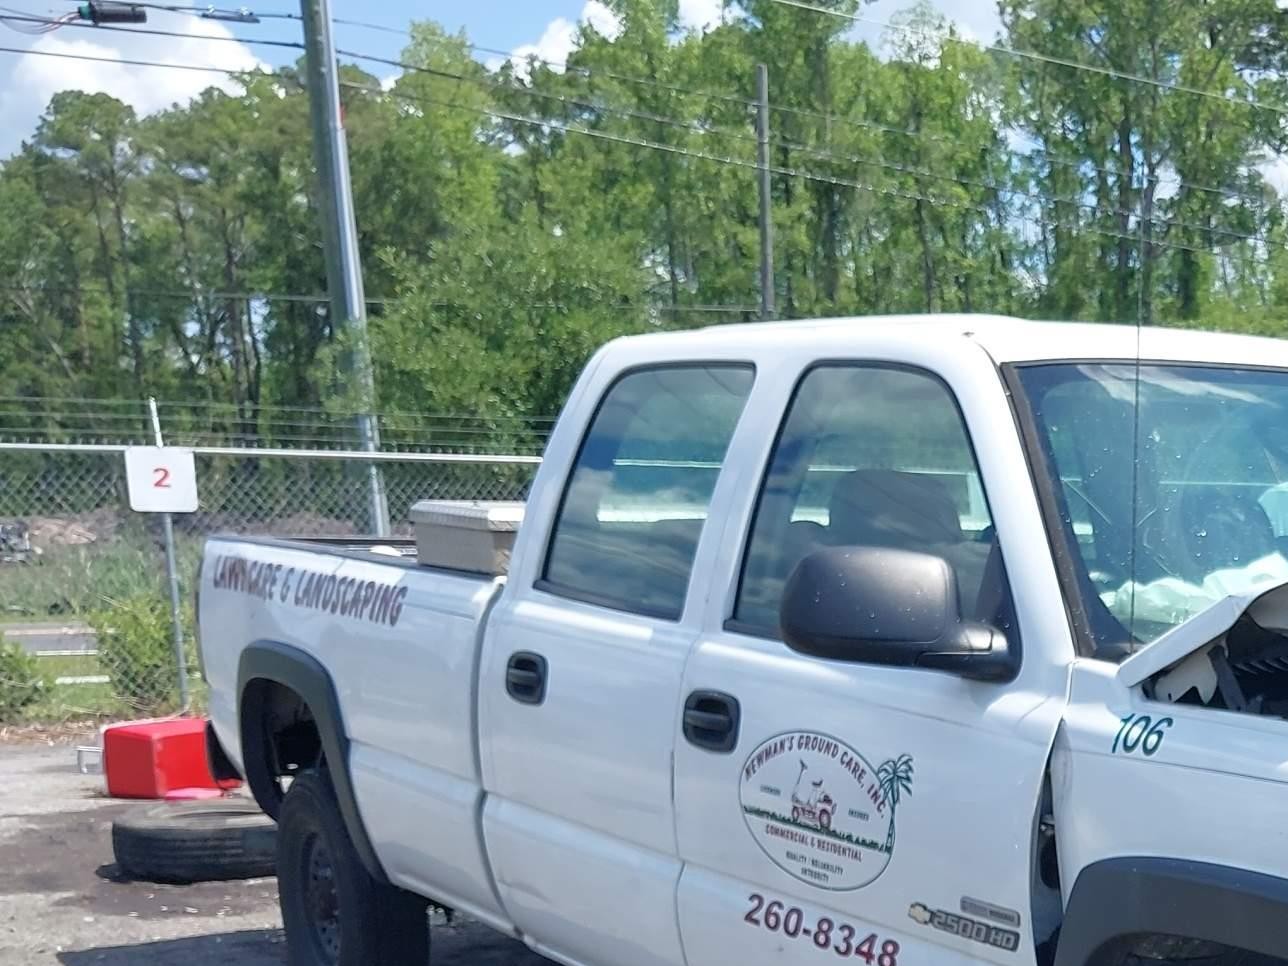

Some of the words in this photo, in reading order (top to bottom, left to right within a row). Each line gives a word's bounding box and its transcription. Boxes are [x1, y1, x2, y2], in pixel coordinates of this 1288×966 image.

[153, 467, 171, 488] 2
[294, 570, 408, 627] LANDSCAPING
[1112, 713, 1173, 756] 106
[745, 736, 794, 782] NEWMAN'S
[798, 735, 838, 759] GROUND
[867, 784, 888, 819] INC.
[765, 824, 809, 846] COMMERCIAL
[817, 840, 862, 862] RESIDENTIAL
[933, 911, 987, 942] 2500
[989, 928, 1016, 950] HD
